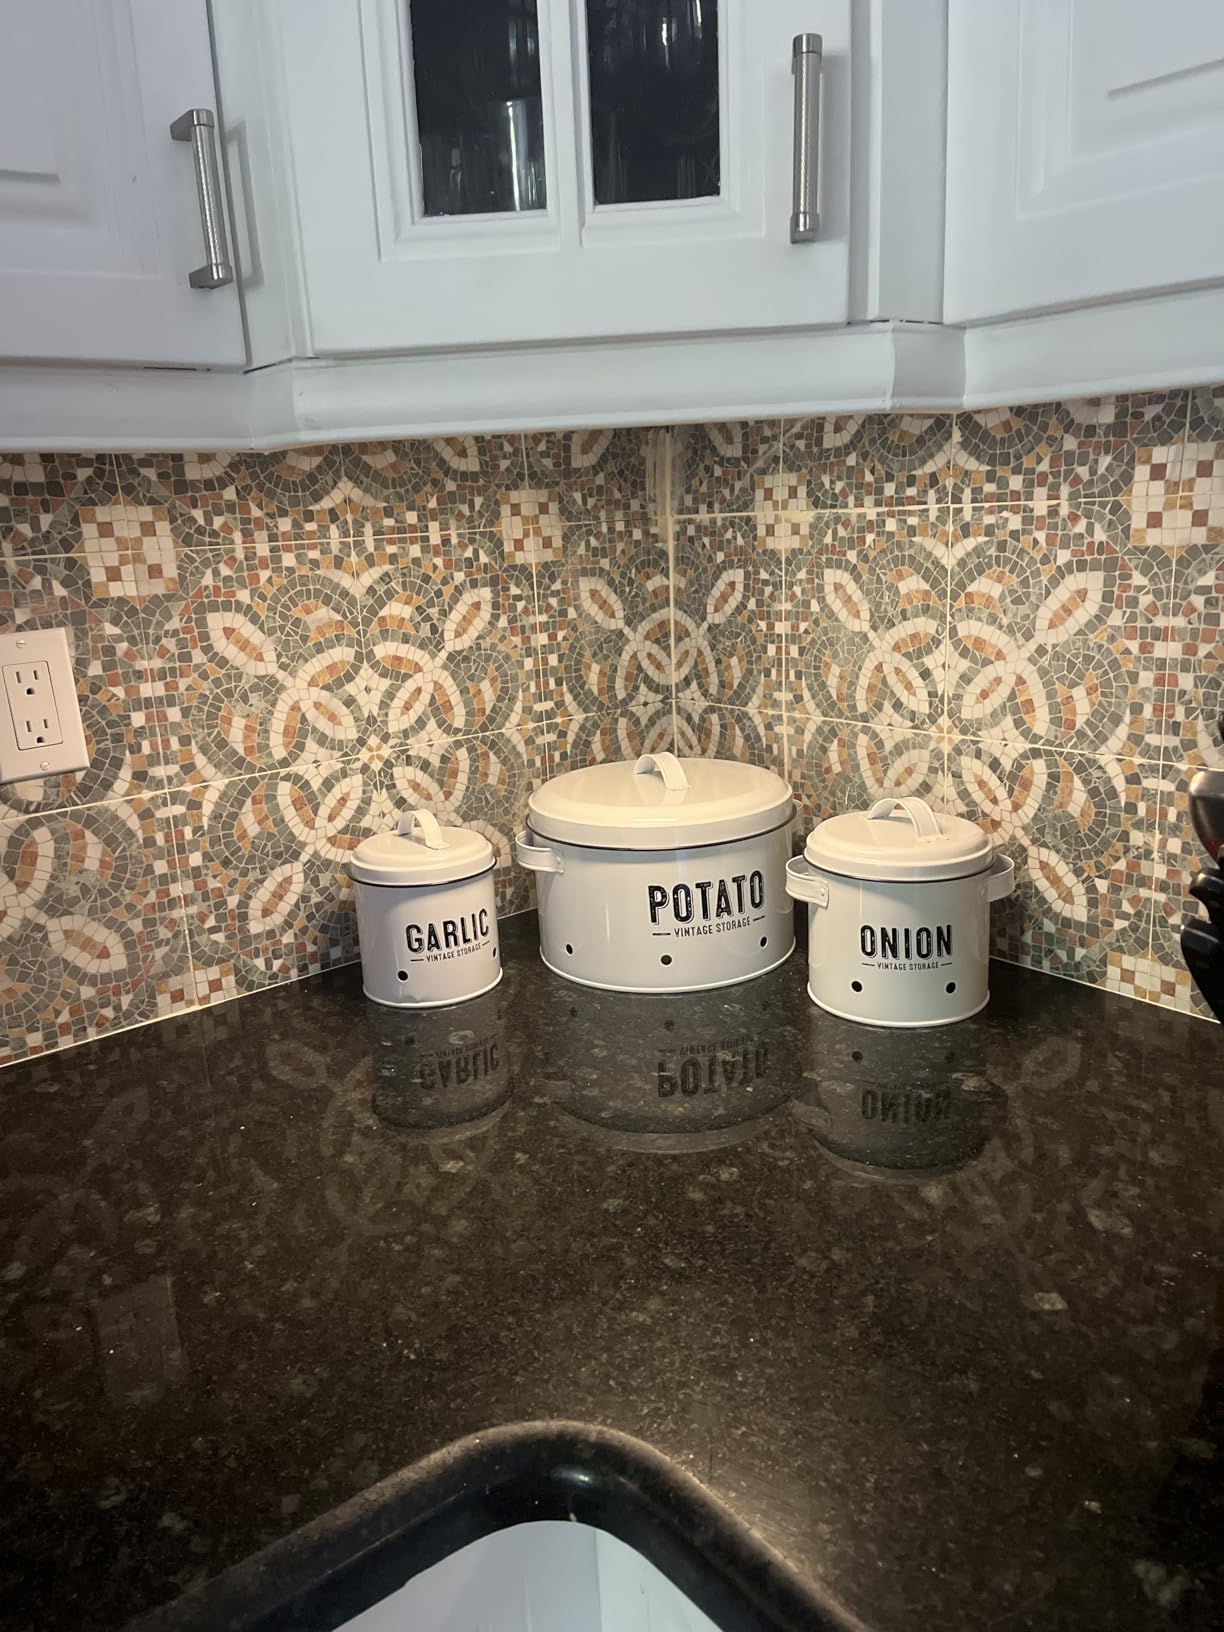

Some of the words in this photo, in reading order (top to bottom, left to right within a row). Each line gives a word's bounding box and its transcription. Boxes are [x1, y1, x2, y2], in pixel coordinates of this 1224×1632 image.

[648, 870, 765, 925] POTATO
[405, 907, 490, 953] GARLIC
[674, 925, 713, 937] VINTAGE
[716, 916, 751, 933] STORAGE
[425, 950, 455, 963] VINTAGE
[456, 942, 481, 957] STORAGE
[860, 923, 953, 960] ONION
[877, 962, 907, 971] VINTAGE
[909, 961, 939, 971] STORAGE
